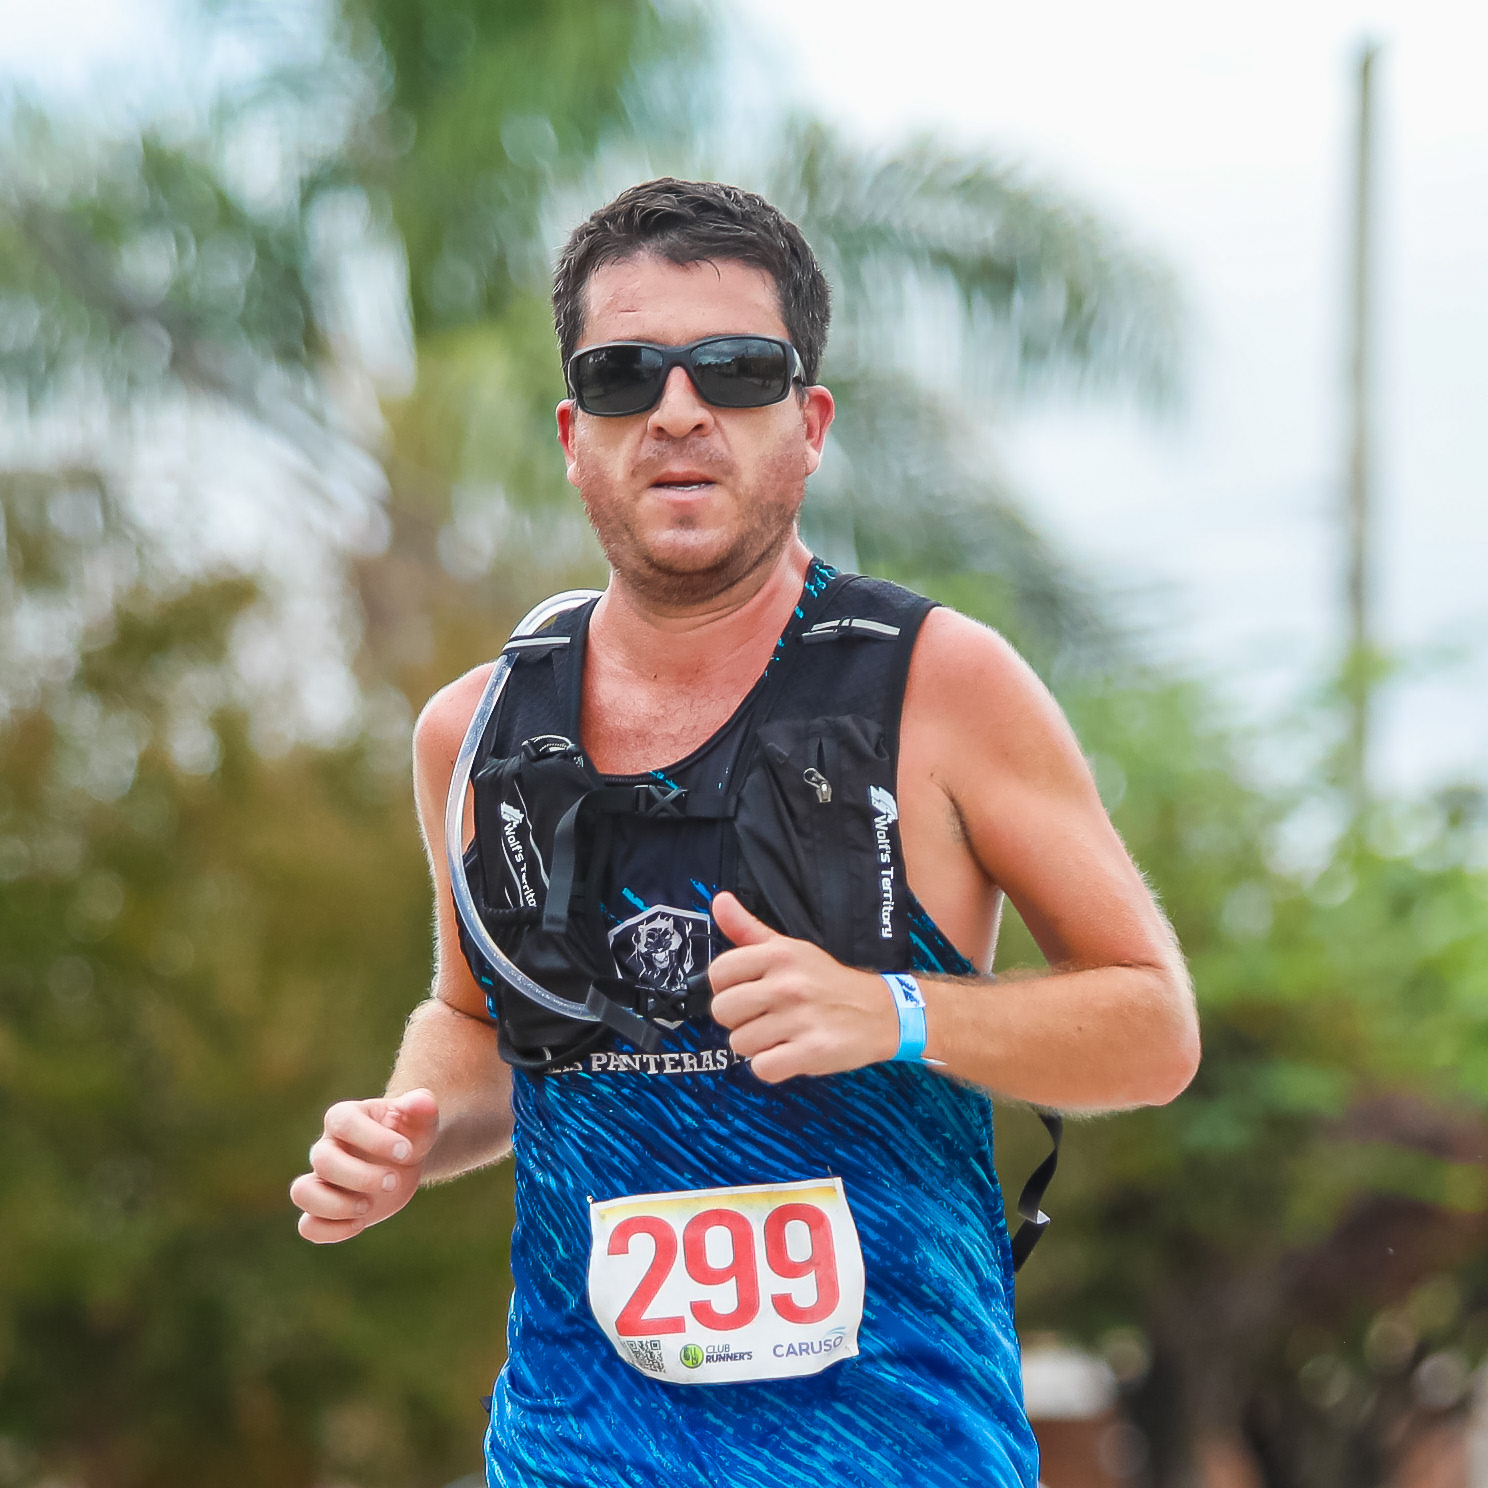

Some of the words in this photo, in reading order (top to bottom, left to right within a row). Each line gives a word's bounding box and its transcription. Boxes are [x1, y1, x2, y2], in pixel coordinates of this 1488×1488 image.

[504, 822, 525, 863] Wolf's
[873, 815, 892, 863] Wolf's
[881, 866, 895, 939] Territory
[590, 1049, 728, 1075] PANTERAS
[607, 1202, 840, 1337] 299
[705, 1344, 730, 1353] CLUB
[705, 1351, 753, 1364] RUNNER'S
[772, 1335, 844, 1358] CARUSO
